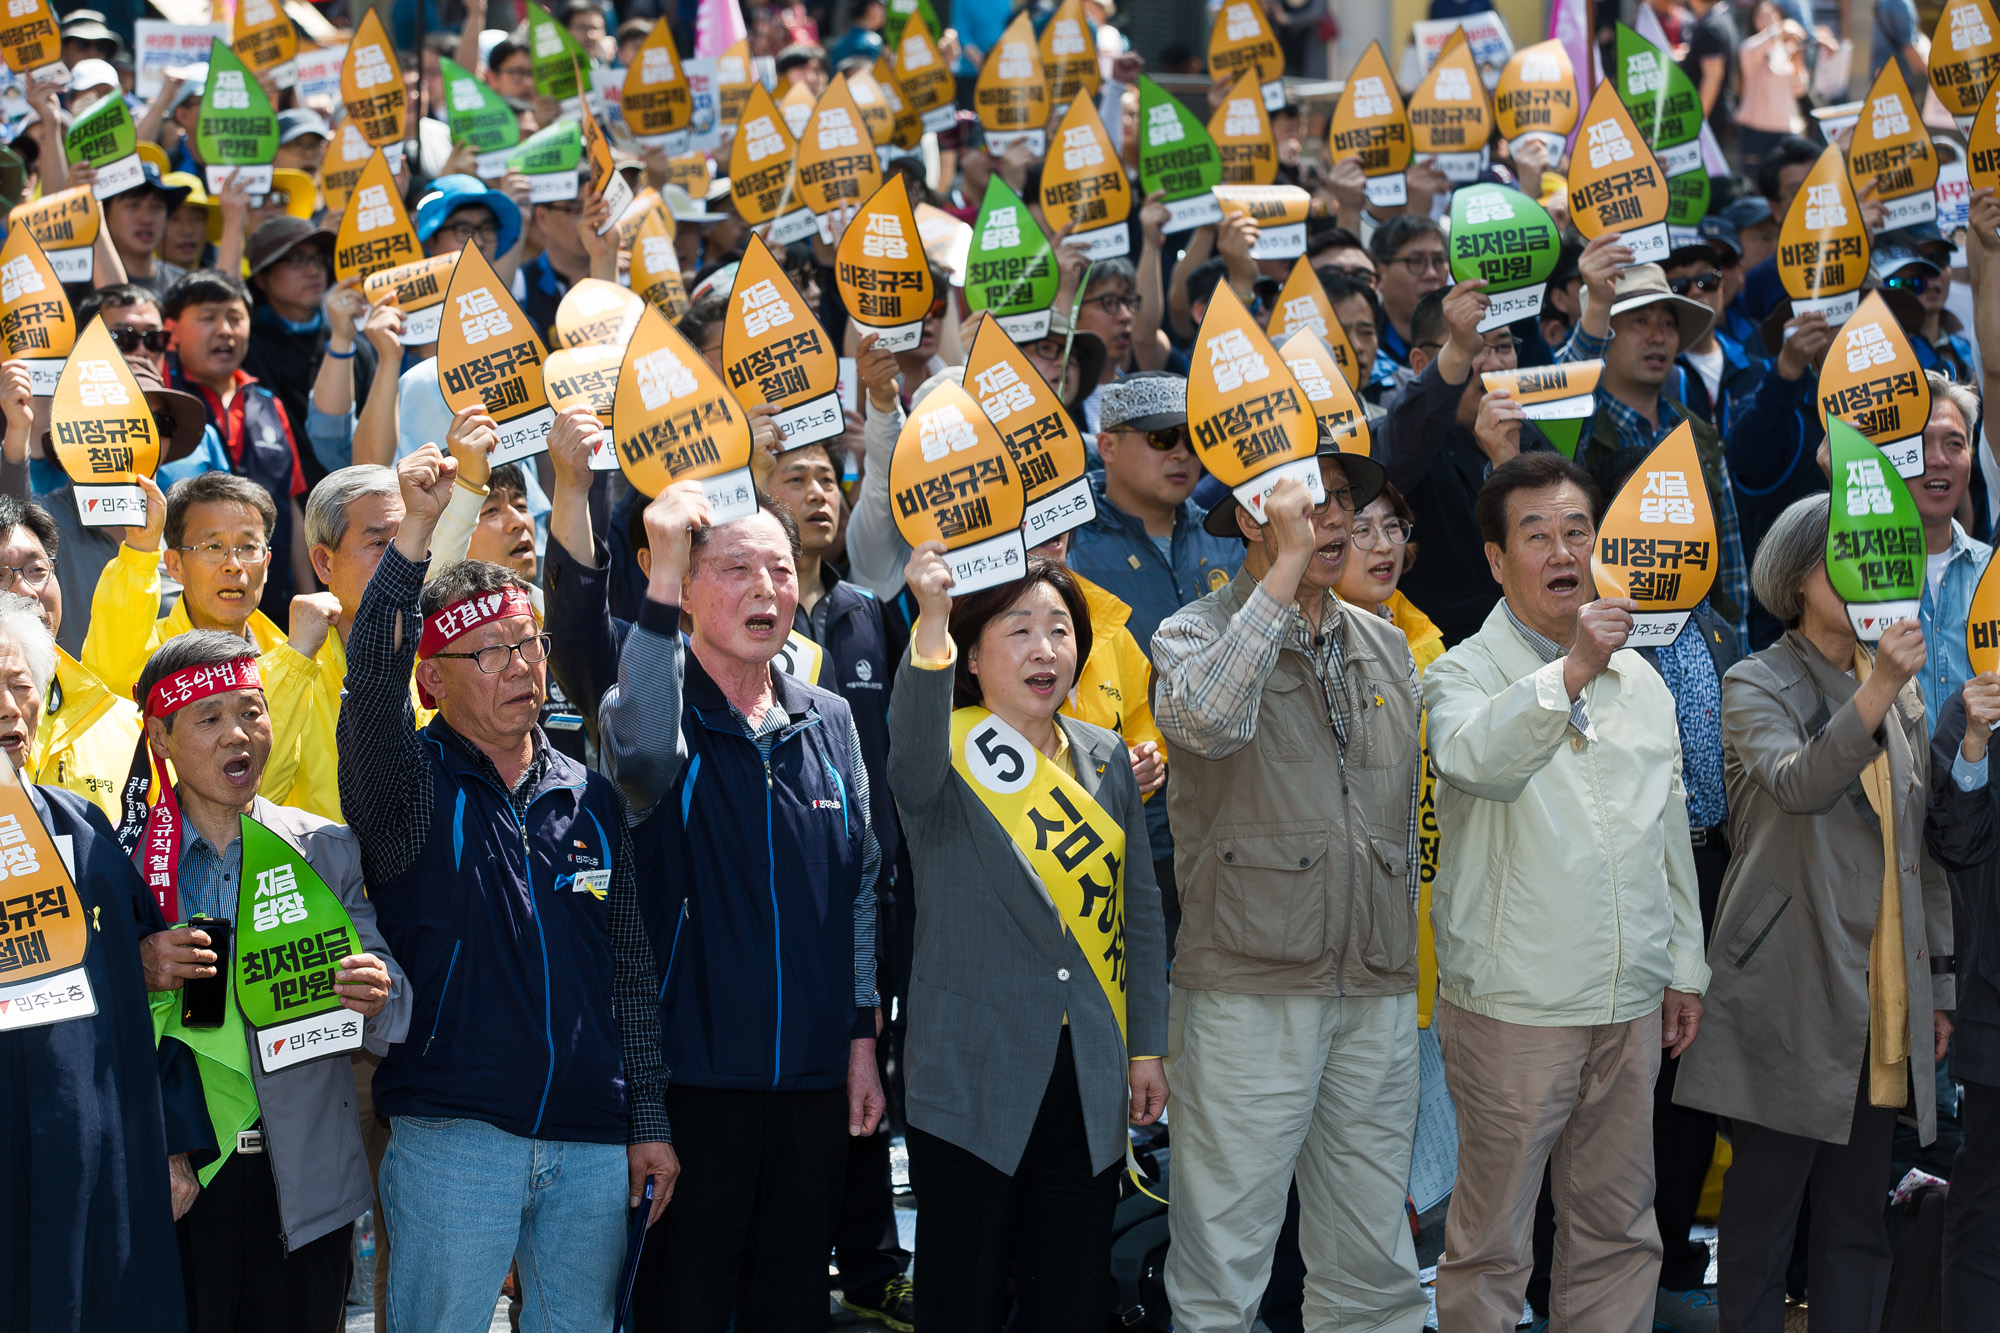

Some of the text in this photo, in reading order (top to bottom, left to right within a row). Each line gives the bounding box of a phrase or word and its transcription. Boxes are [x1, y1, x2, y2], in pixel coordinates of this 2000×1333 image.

[1949, 3, 1984, 30] 지금
[1951, 23, 1992, 51] 당장
[1587, 118, 1623, 147] 지금
[800, 153, 873, 186] 비정규직
[1589, 138, 1634, 169] 당장
[1852, 142, 1929, 177] 비정규직
[1044, 171, 1122, 206] 비정규직
[1570, 165, 1657, 212] 비정규직
[864, 212, 903, 237] 지금
[984, 206, 1019, 229] 지금
[1598, 195, 1644, 227] 철폐
[339, 232, 413, 271] 비정규직
[862, 234, 909, 260] 당장
[981, 224, 1022, 252] 당장
[1454, 225, 1551, 260] 최저임금
[1634, 229, 1665, 250] 주노총
[1781, 235, 1862, 269] 비정규직
[396, 274, 439, 299] 철폐
[839, 262, 924, 294] 비정규직
[969, 255, 1050, 286] 최저임금
[1476, 254, 1532, 285] 1만원
[2, 274, 46, 305] 당장
[455, 286, 500, 319] 지금
[739, 278, 783, 314] 지금
[858, 291, 901, 318] 철폐
[462, 307, 513, 345] 당장
[742, 300, 796, 339] 당장
[1845, 321, 1886, 350] 지금
[7, 326, 51, 355] 철폐
[1206, 327, 1256, 366] 지금
[76, 359, 119, 381] 지금
[443, 340, 542, 396] 비정규직
[727, 328, 823, 389] 비정규직
[1212, 352, 1271, 394] 당장
[1845, 343, 1898, 373] 당장
[79, 379, 130, 408] 당장
[479, 376, 530, 414] 철폐
[549, 366, 621, 400] 비정규
[758, 365, 811, 404] 철폐
[973, 359, 1020, 400] 지금
[1822, 370, 1920, 418] 비정규직
[918, 403, 969, 438] 지금
[981, 383, 1037, 425] 당장
[1193, 387, 1305, 452] 비정규직
[1852, 404, 1902, 438] 철폐
[56, 418, 151, 446] 비정규직
[780, 408, 838, 438] 민주노총
[1002, 412, 1069, 461] 정규직
[918, 422, 979, 464] 당장
[1232, 424, 1292, 470] 철폐
[88, 447, 134, 474] 철폐
[1845, 458, 1887, 488] 지금
[895, 455, 1010, 519] 비정규직
[1642, 471, 1689, 498] 지금
[1846, 485, 1895, 517] 당장
[933, 496, 994, 538] 철폐
[1029, 491, 1089, 531] 민주노총
[1639, 497, 1695, 525] 당장
[1601, 537, 1711, 571] 비정규직
[1833, 527, 1922, 562] 최저임금
[956, 546, 1020, 581] 민주노총
[1858, 560, 1916, 592] 1만원
[1628, 570, 1682, 602] 철폐
[434, 600, 482, 640] 단결
[160, 662, 237, 708] 노동악법
[974, 727, 1026, 783] 5
[86, 778, 114, 793] 정의당
[576, 854, 598, 866] 민주노총
[254, 863, 298, 900] 지금
[254, 891, 308, 932] 당장
[242, 926, 353, 986] 최저임금
[14, 984, 85, 1012] 민주노총
[270, 968, 337, 1012] 1만원
[290, 1021, 358, 1050] 민주노총
